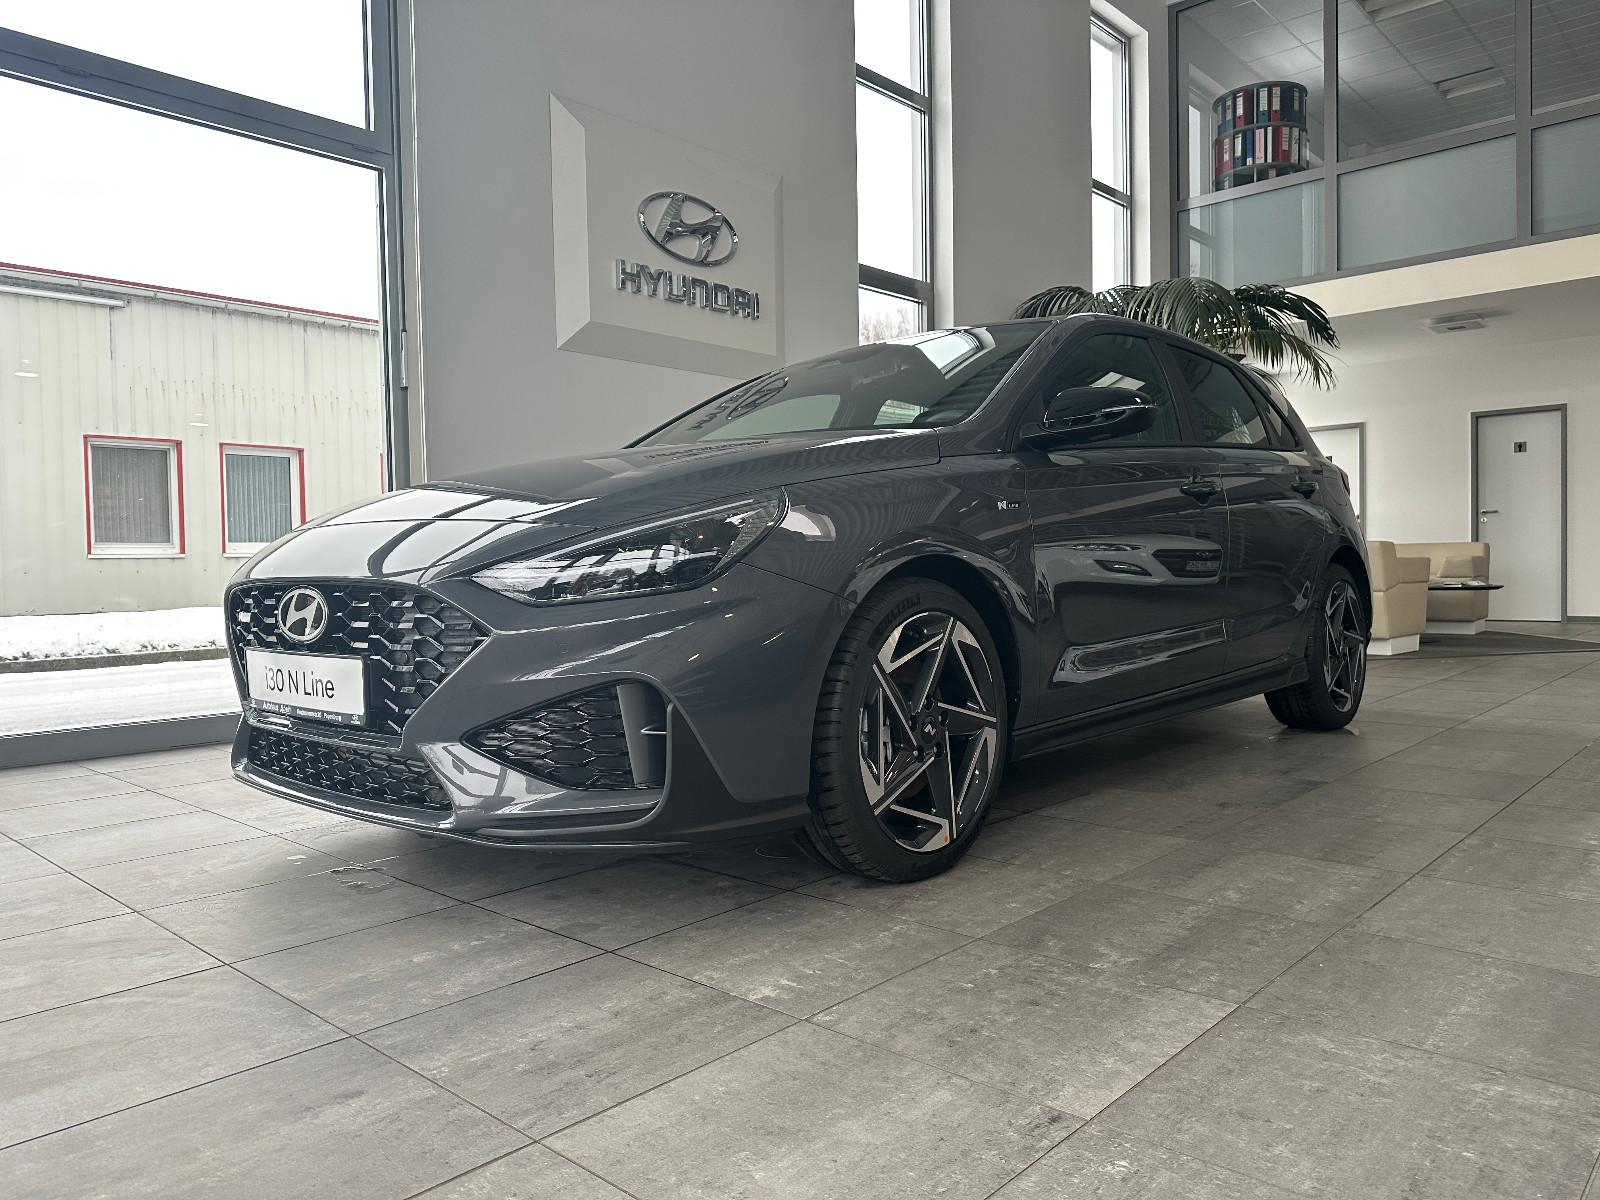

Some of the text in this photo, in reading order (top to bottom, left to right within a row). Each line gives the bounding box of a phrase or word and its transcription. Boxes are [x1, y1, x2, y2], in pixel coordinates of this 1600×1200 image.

[615, 258, 760, 321] HYUNDAI
[264, 665, 335, 699] i30 N Line
